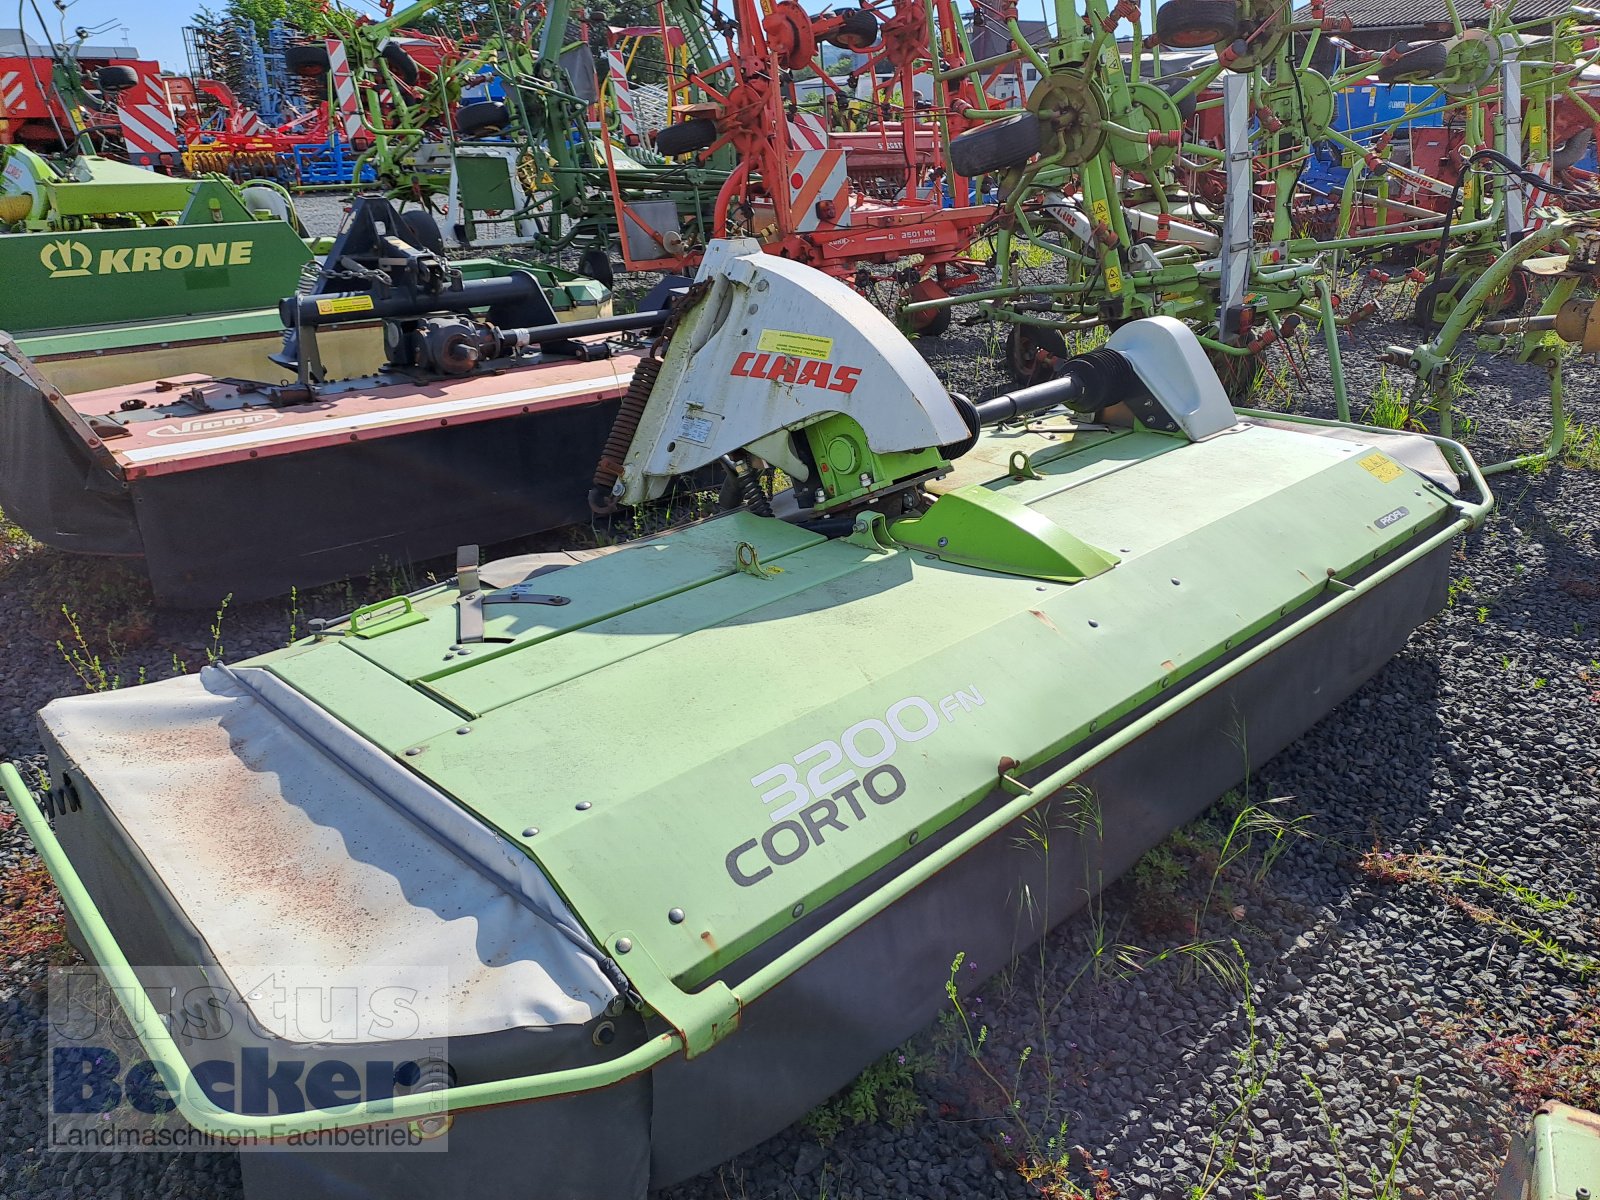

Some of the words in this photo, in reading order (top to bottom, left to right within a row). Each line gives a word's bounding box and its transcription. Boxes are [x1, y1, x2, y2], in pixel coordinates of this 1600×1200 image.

[98, 241, 254, 275] KRONE
[730, 351, 863, 394] CLAAS
[166, 414, 264, 434] Vicon
[750, 696, 940, 823] 3200
[938, 684, 986, 722] FN
[725, 764, 907, 887] CORTO
